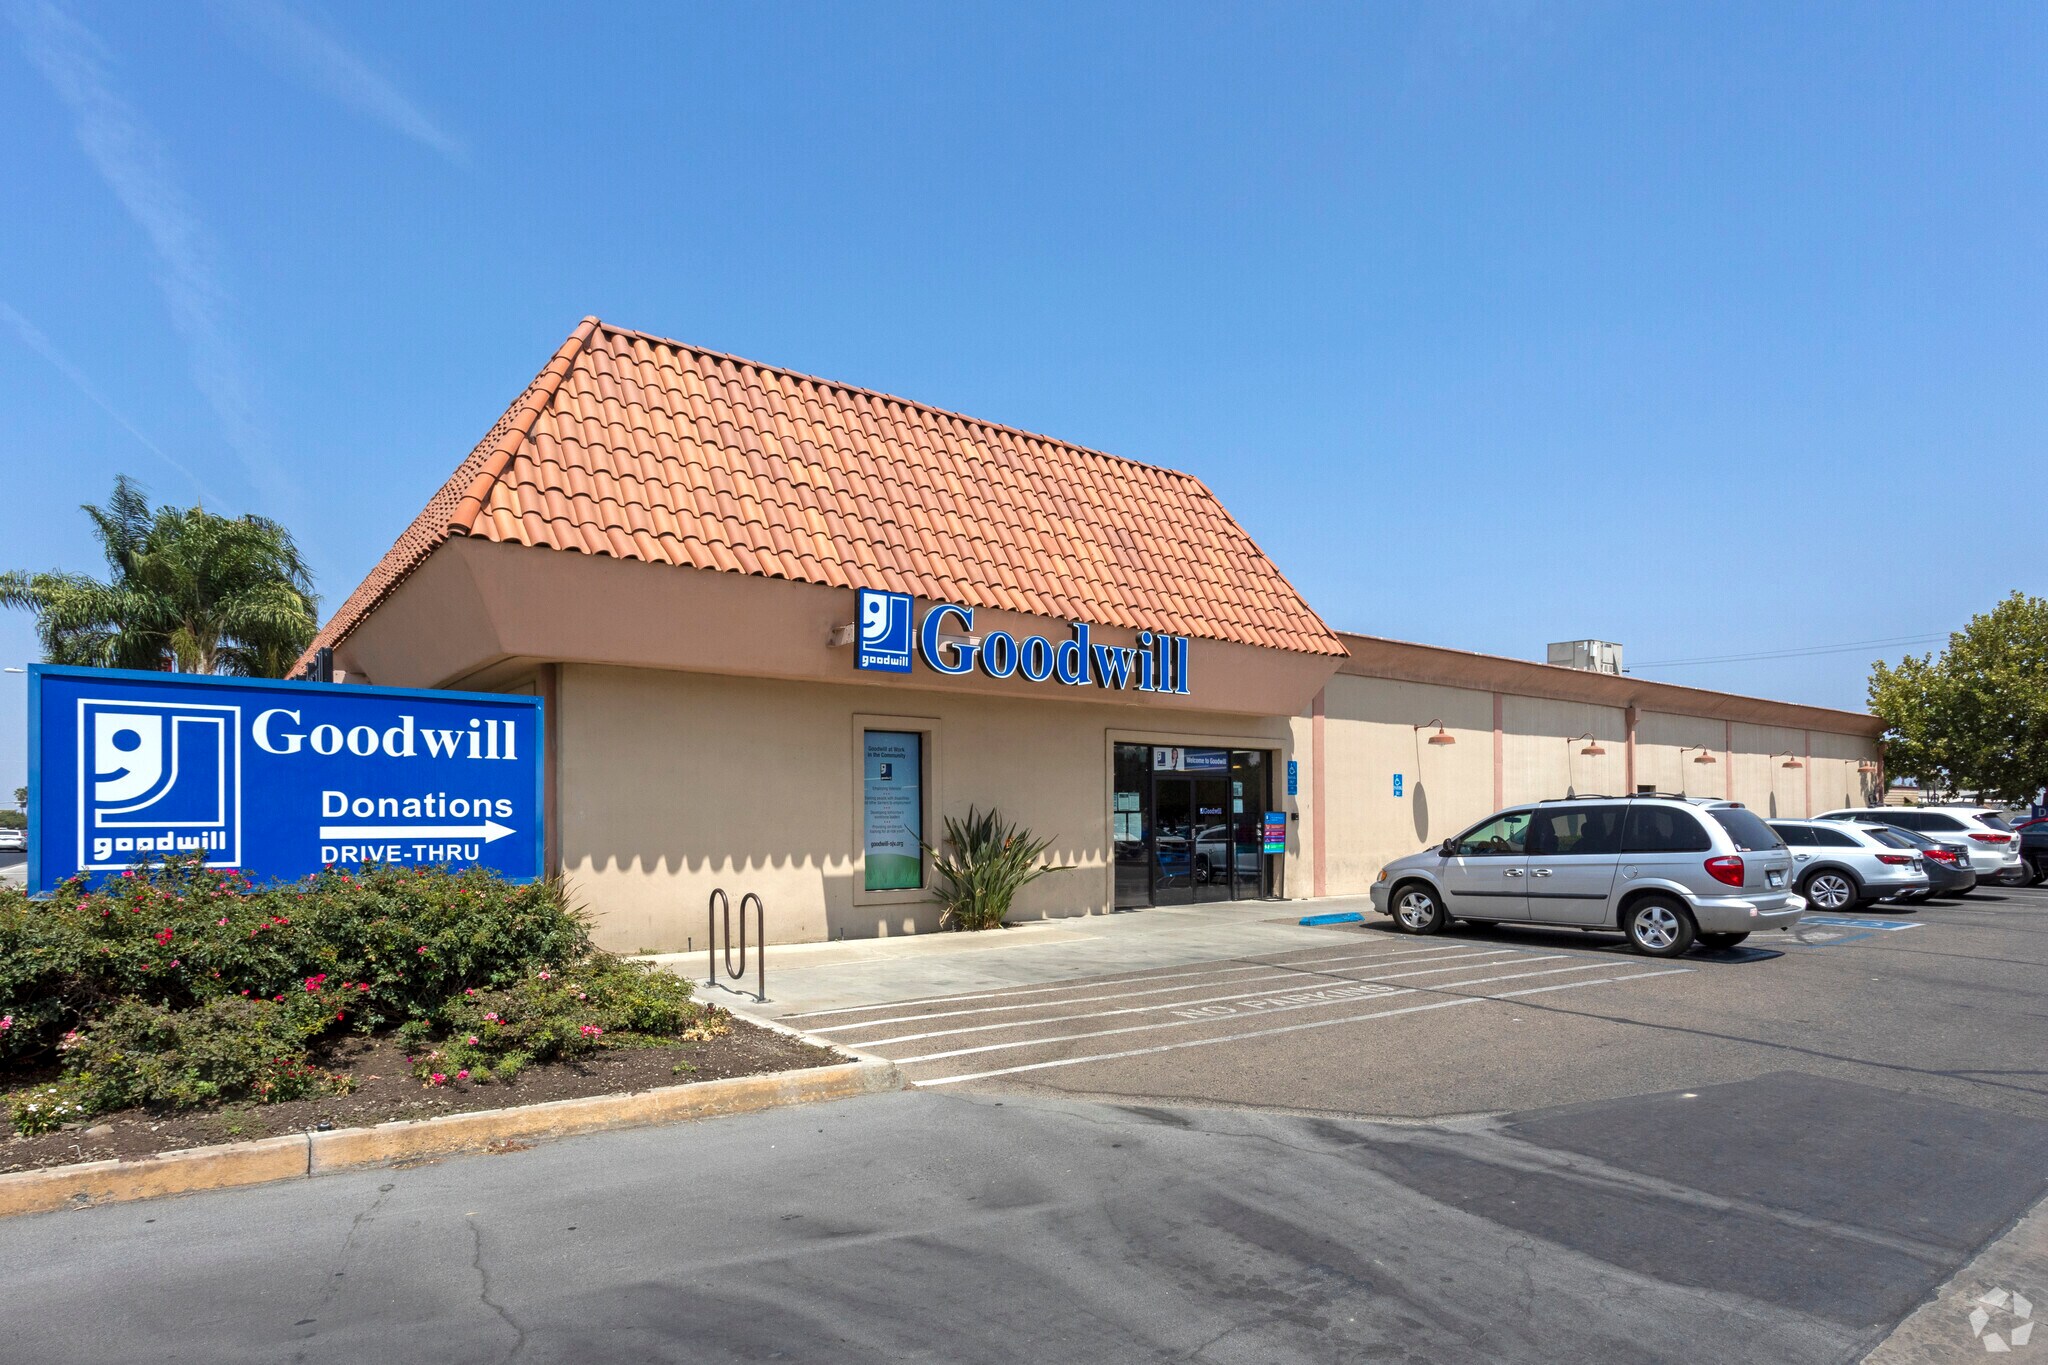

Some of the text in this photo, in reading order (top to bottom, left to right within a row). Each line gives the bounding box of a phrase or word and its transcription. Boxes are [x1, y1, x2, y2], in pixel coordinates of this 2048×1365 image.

[861, 653, 909, 668] goodwill
[918, 603, 1191, 695] Goodwill
[252, 708, 518, 760] Goodwill
[1186, 756, 1204, 764] Welcome
[1210, 757, 1227, 765] Goodwill
[322, 790, 513, 818] Donations
[1203, 807, 1222, 815] Goodwill
[94, 831, 226, 861] goodwill
[321, 844, 479, 864] DRIVE-THRU
[1169, 985, 1395, 1019] NO PARKING
